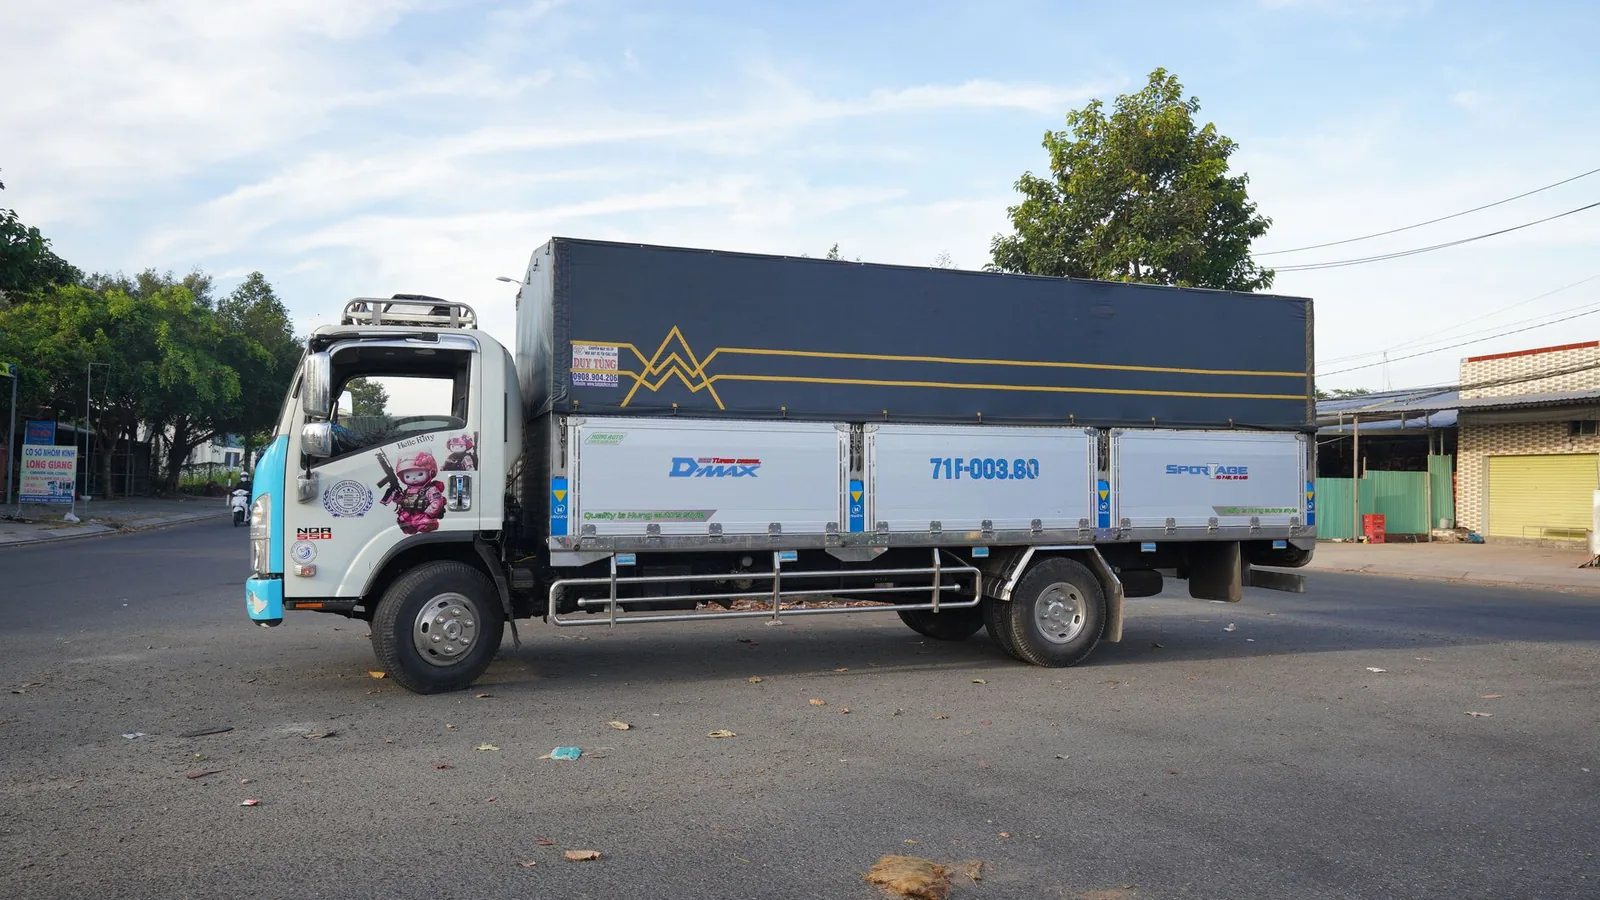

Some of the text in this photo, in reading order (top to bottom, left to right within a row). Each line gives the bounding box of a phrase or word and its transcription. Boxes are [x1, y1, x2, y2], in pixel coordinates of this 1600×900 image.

[573, 356, 616, 369] DUY TÙNG
[573, 372, 618, 382] 0908.904.206
[396, 434, 435, 449] Hello Kitty
[26, 460, 72, 470] LONG GIANG
[930, 458, 1039, 480] 71F-003.60
[584, 512, 616, 520] Quality
